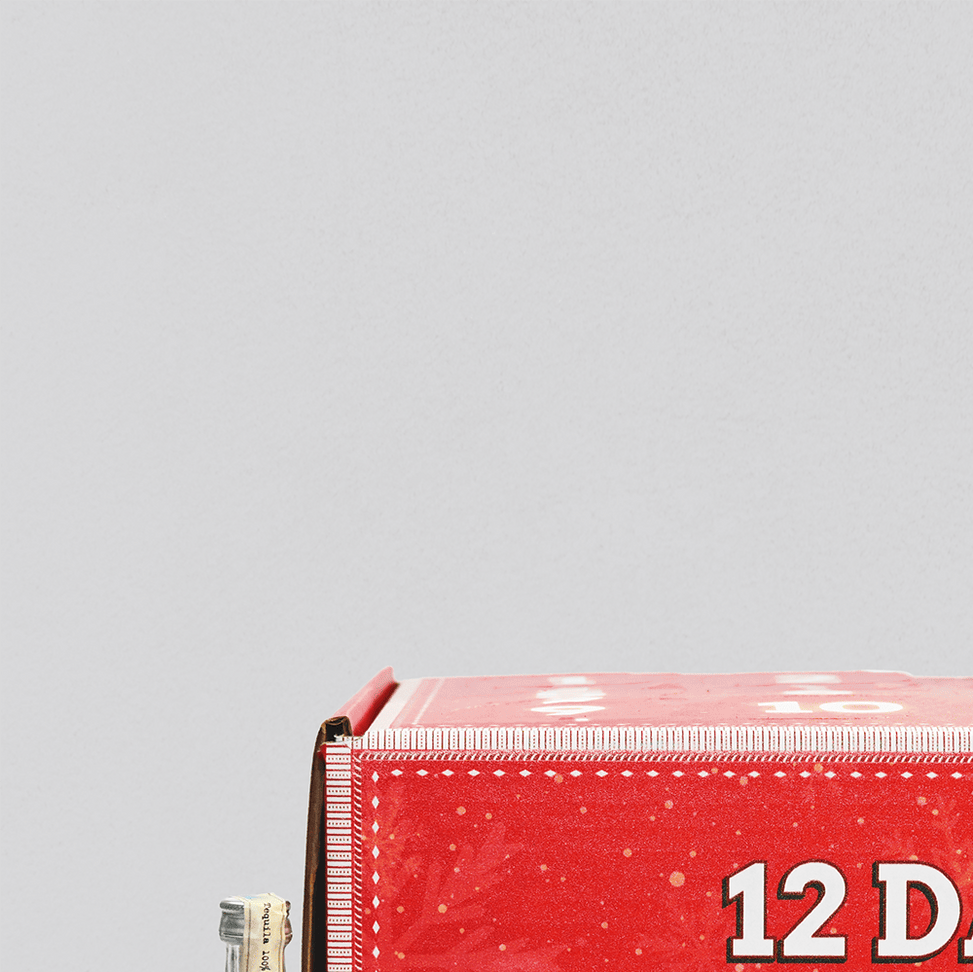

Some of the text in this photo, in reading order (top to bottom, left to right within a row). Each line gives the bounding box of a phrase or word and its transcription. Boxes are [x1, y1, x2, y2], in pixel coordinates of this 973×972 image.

[757, 701, 904, 713] 10
[261, 903, 272, 945] Tequila
[724, 861, 847, 963] 12
[259, 950, 271, 971] 100%
